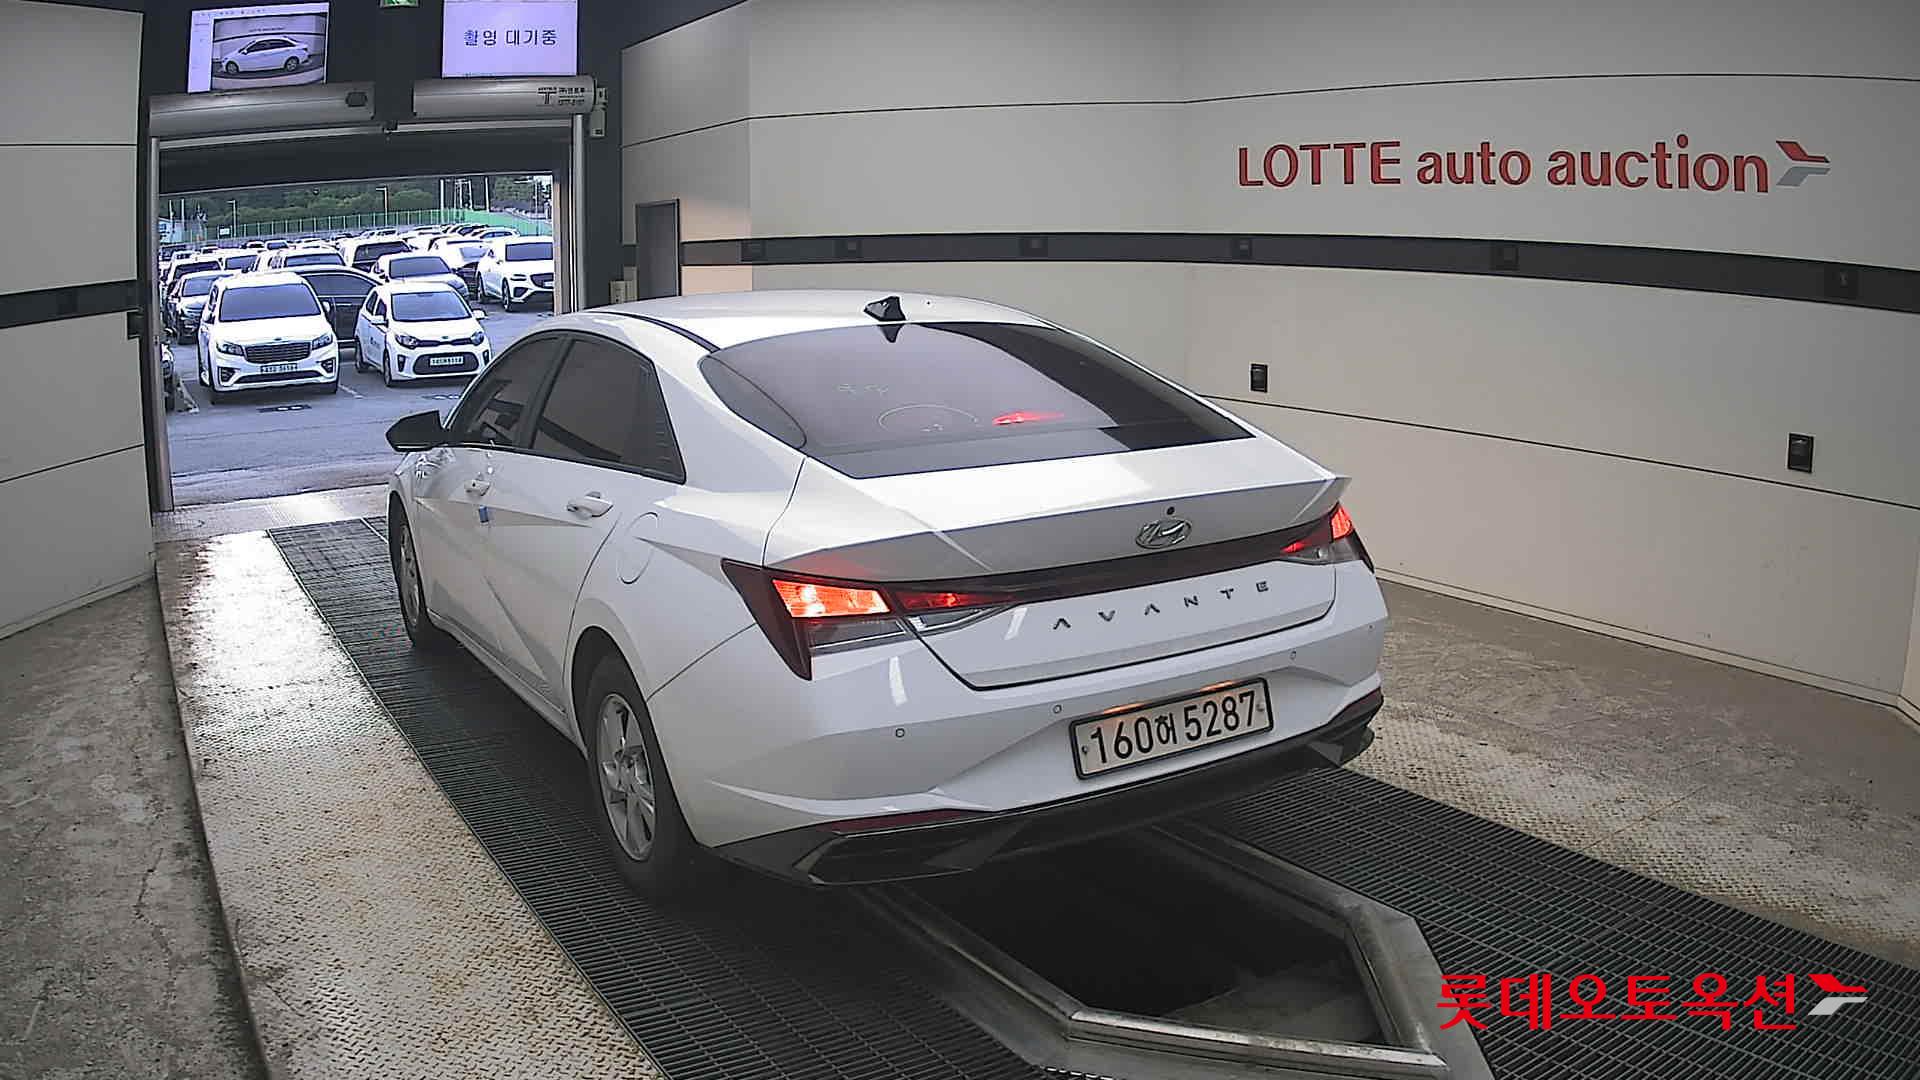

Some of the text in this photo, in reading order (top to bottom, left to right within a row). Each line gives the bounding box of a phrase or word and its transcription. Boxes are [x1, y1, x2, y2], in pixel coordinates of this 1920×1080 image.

[505, 29, 557, 46] 대기중
[1238, 134, 1770, 194] LOTTE auto auction
[1053, 580, 1269, 630] AVANTE
